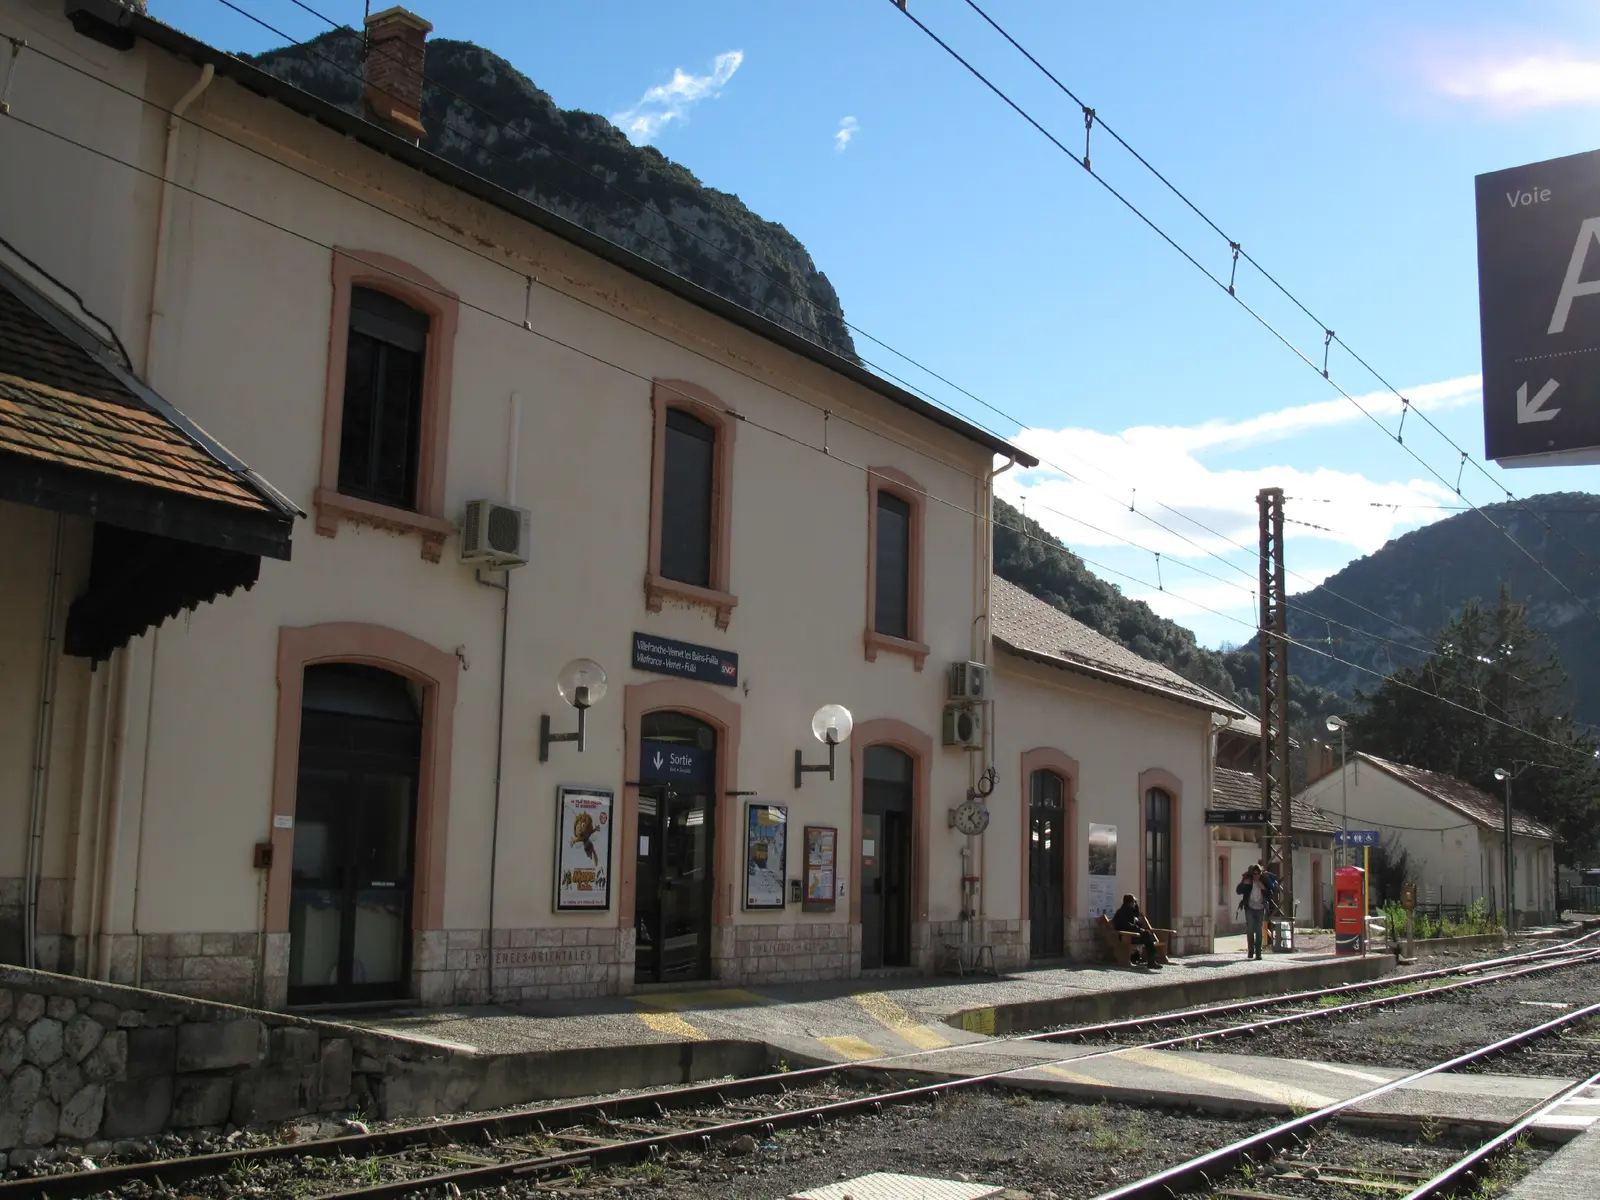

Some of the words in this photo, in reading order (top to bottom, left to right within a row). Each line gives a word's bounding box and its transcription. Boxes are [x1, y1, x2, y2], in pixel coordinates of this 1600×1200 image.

[1506, 186, 1552, 208] Voie
[1547, 216, 1600, 335] A
[721, 665, 736, 674] SNCF
[670, 753, 692, 766] Sortie
